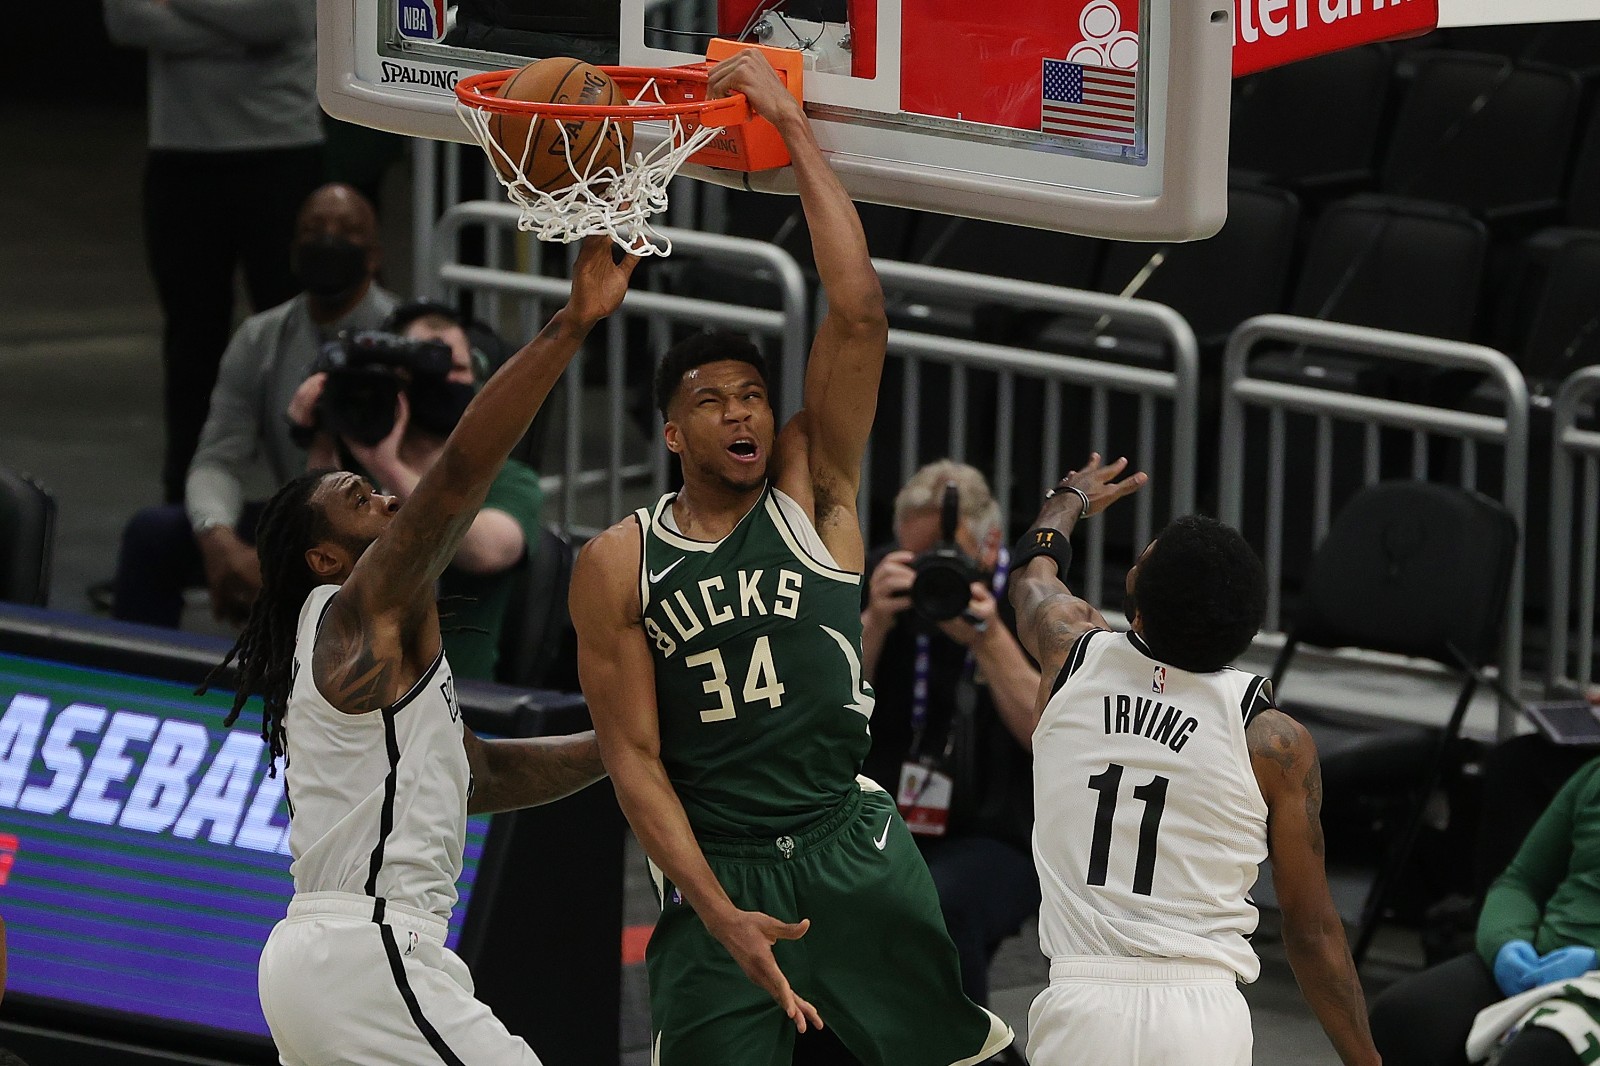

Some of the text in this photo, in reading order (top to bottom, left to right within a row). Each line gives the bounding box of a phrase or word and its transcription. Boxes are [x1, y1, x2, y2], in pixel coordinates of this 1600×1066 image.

[403, 6, 428, 32] NBA
[380, 60, 459, 92] SPALDING
[644, 568, 803, 658] BUCKS
[685, 635, 786, 723] 34
[1103, 695, 1199, 754] IRVING
[0, 693, 293, 856] ASEBAL
[1086, 763, 1170, 896] 11
